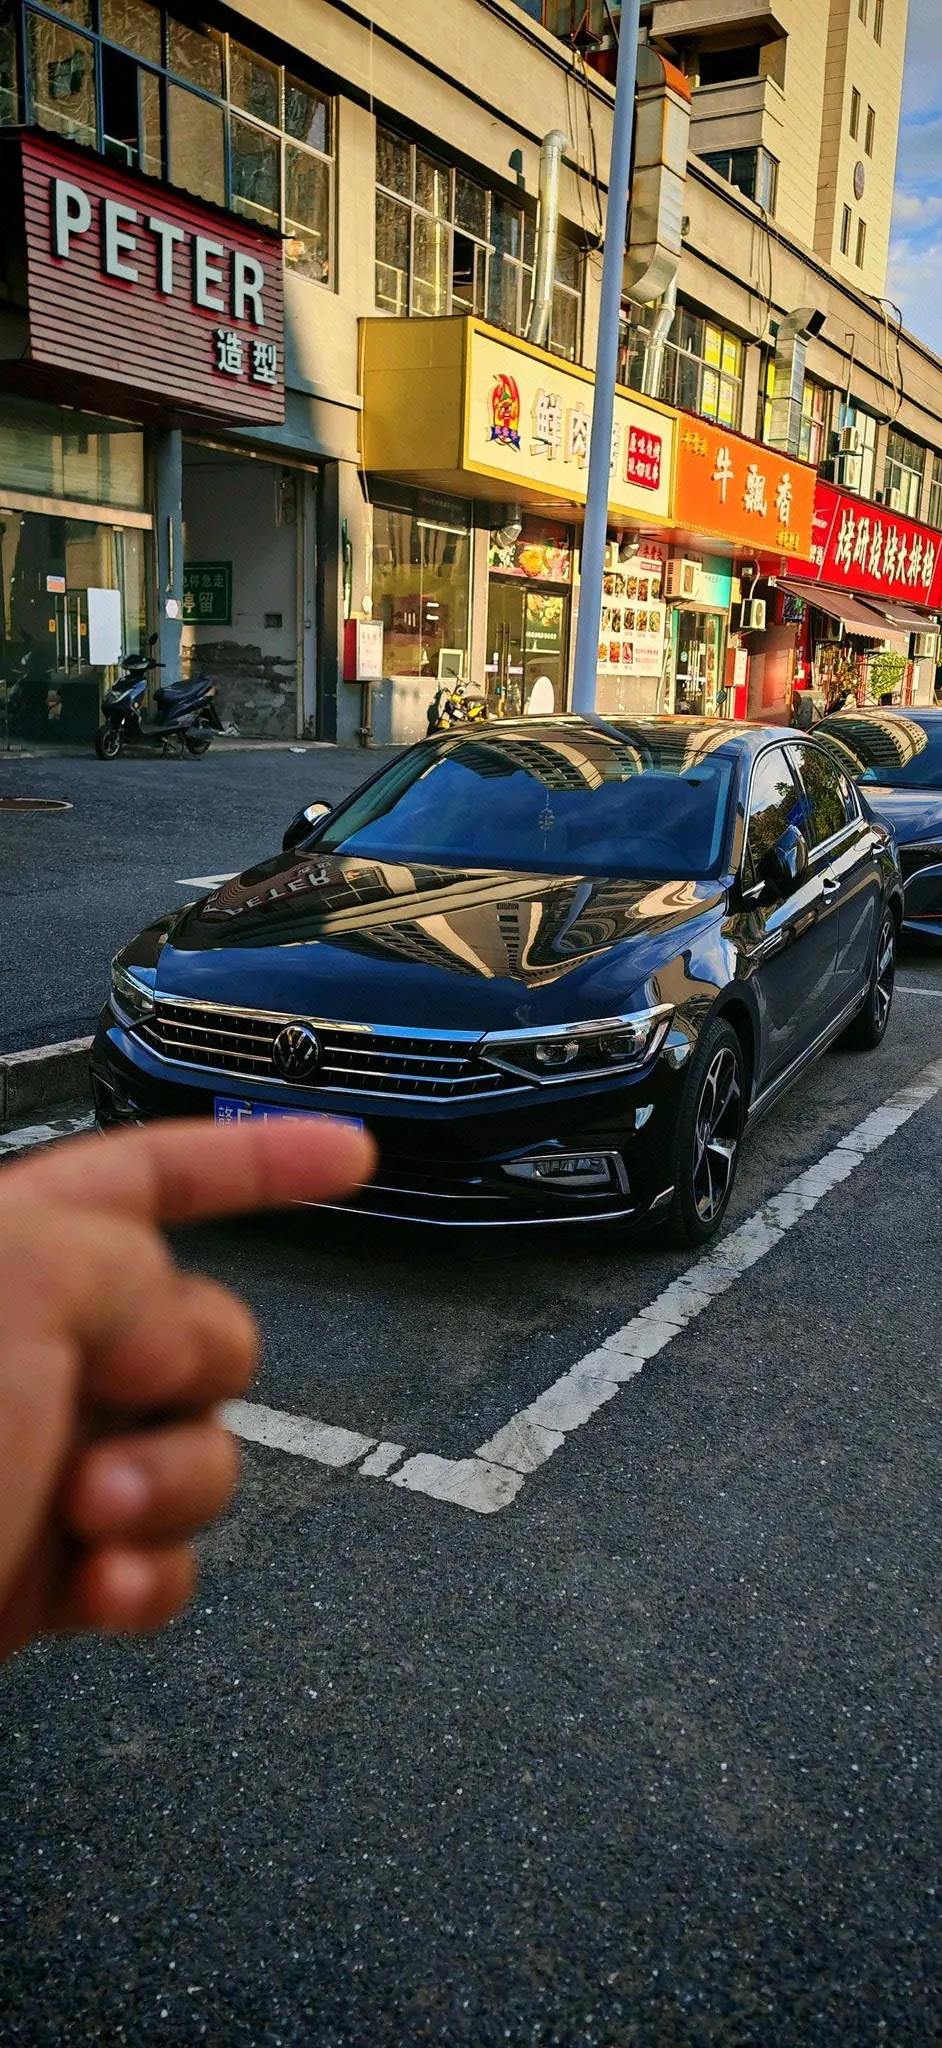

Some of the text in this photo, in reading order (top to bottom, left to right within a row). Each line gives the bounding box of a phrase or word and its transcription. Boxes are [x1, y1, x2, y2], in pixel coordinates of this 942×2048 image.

[51, 178, 265, 326] PETER
[215, 329, 278, 386] 造型
[530, 388, 620, 478] 鲜肉
